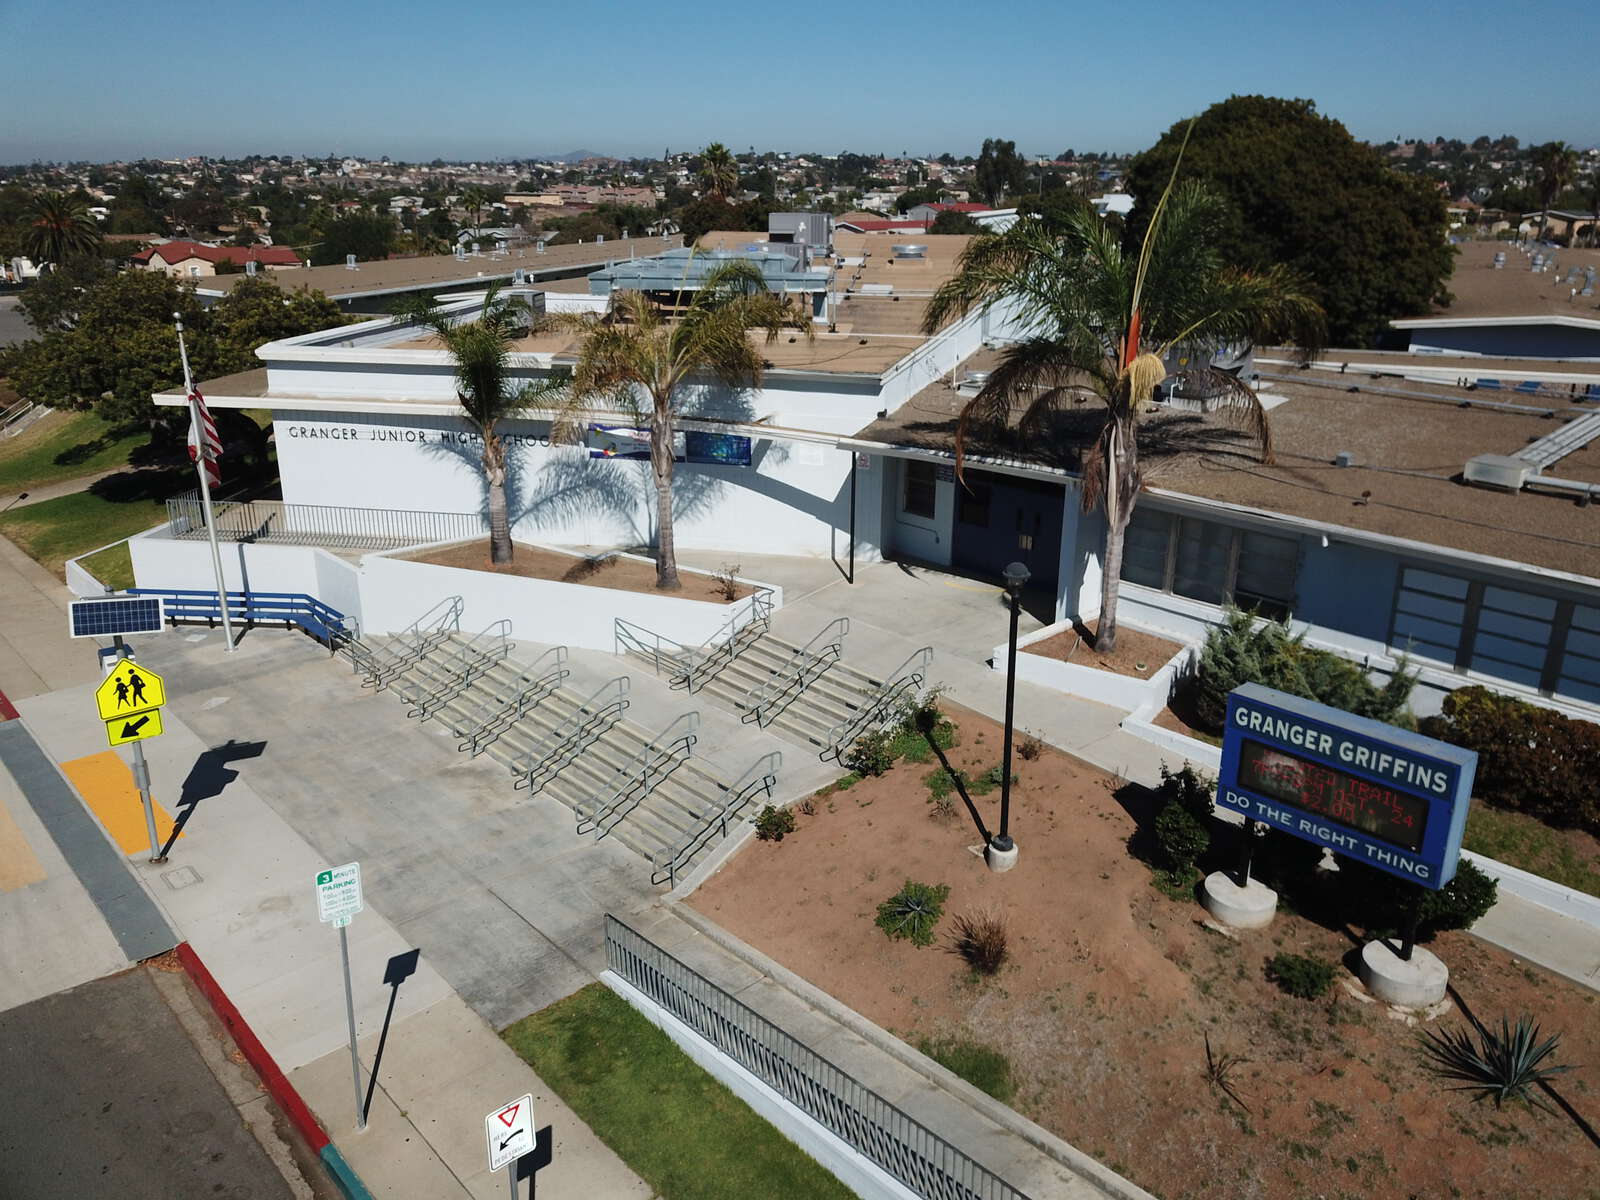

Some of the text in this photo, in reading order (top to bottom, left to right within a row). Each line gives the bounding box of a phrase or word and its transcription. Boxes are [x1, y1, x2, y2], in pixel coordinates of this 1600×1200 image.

[289, 426, 560, 448] GRANGER JUNIOR HIGH CHOO
[1235, 707, 1332, 756] GRANGER
[1339, 741, 1448, 793] GRIFFINS
[1350, 778, 1404, 812] TRAIL
[1391, 806, 1414, 827] 24
[1226, 791, 1430, 879] DO THE RIGHT THING
[322, 868, 355, 883] 3 MINUTE
[322, 878, 356, 892] PARKING
